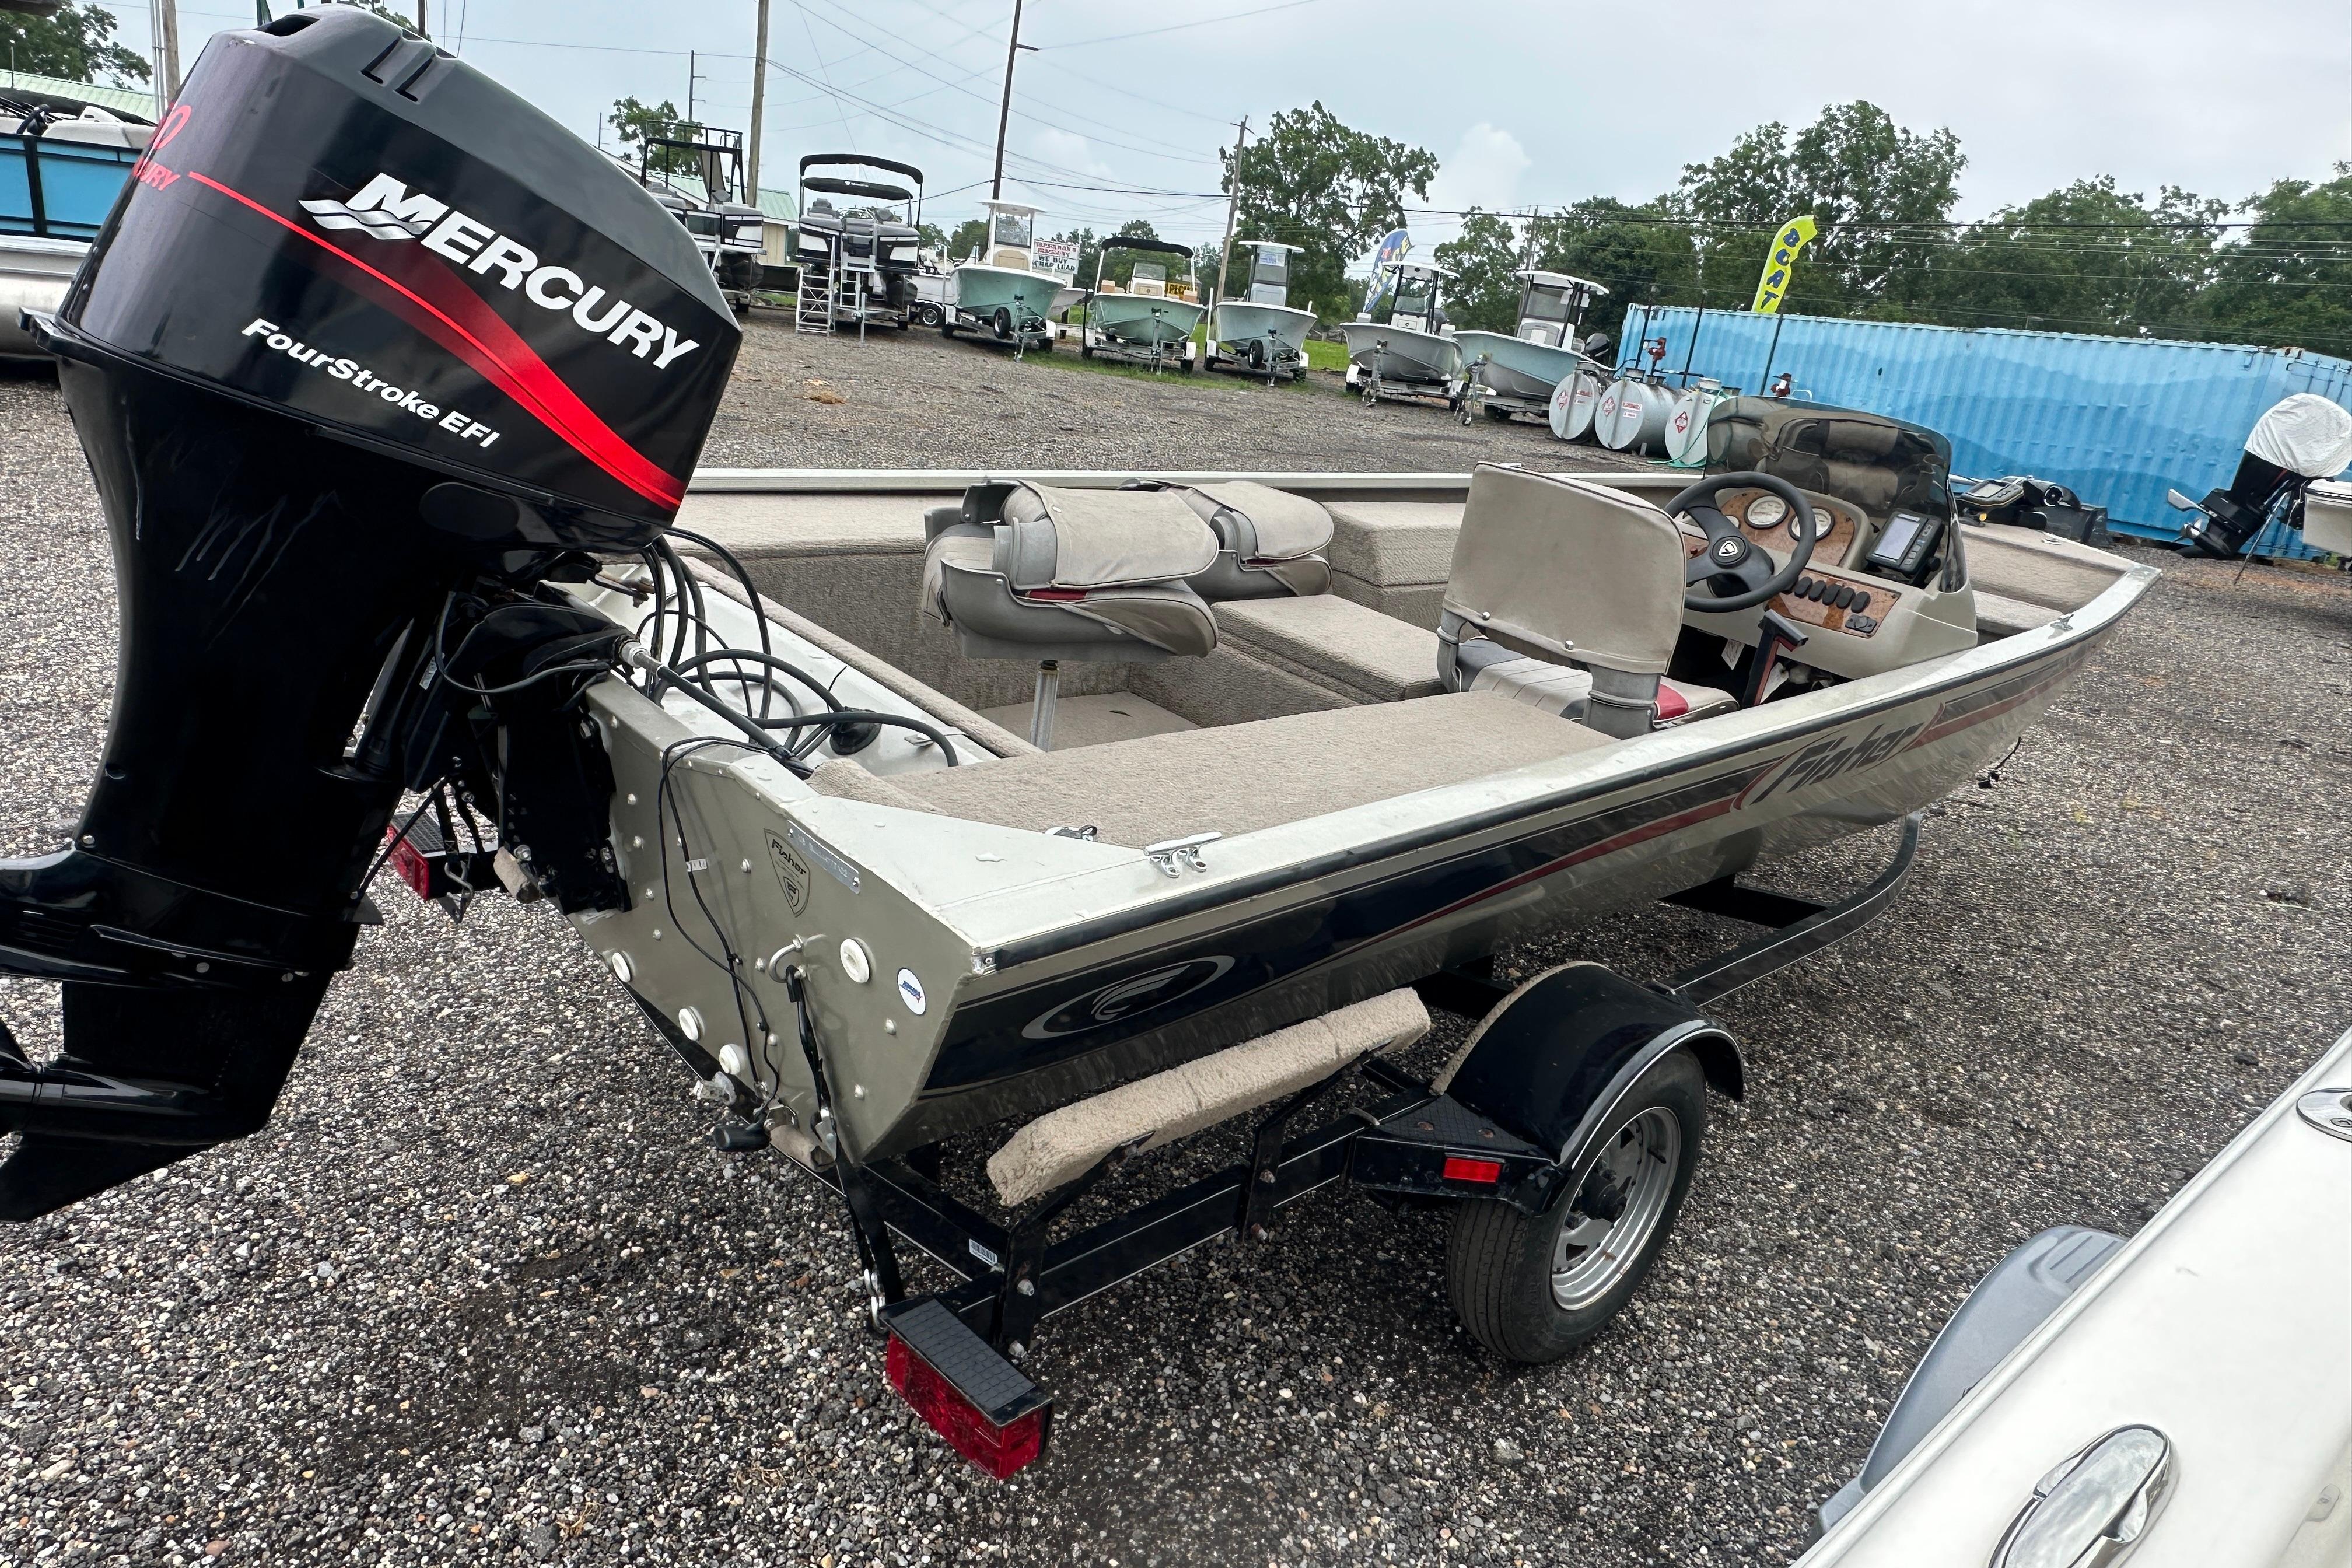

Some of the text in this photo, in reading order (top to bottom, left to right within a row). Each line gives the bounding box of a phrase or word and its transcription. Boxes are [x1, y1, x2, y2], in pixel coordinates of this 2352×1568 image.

[345, 172, 700, 369] MERCURY
[1760, 228, 1800, 309] BOAT
[242, 318, 501, 448] FourStroke EFI
[1750, 723, 1925, 806] Fisher
[771, 838, 807, 875] Fisher
